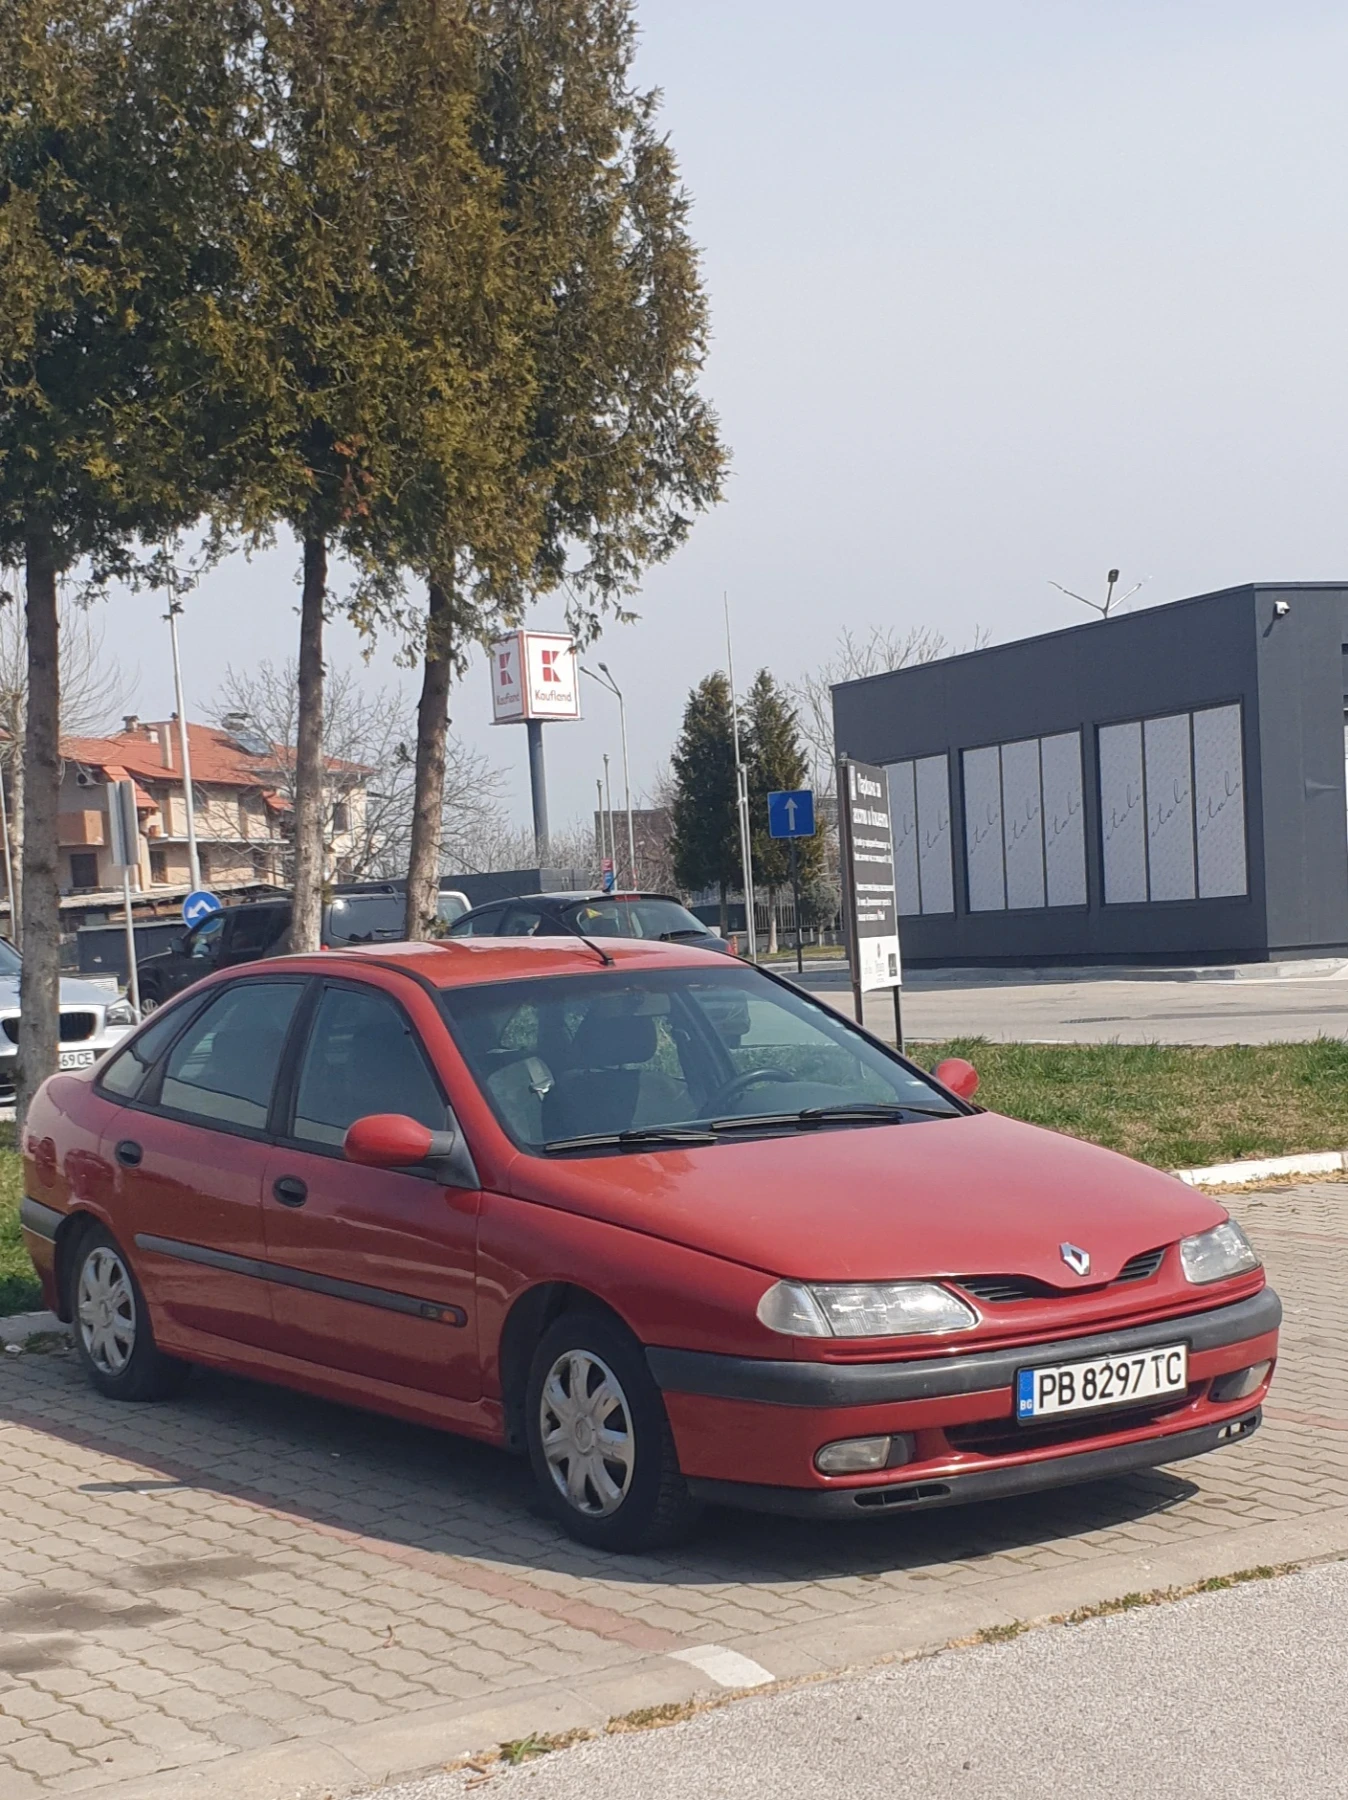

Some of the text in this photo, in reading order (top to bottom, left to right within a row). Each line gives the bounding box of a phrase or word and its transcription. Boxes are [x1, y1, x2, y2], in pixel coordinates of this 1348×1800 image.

[535, 690, 572, 702] Kaufland
[77, 1053, 93, 1065] CE
[1039, 1352, 1182, 1409] PB 8297 TC
[1020, 1399, 1033, 1411] BG
